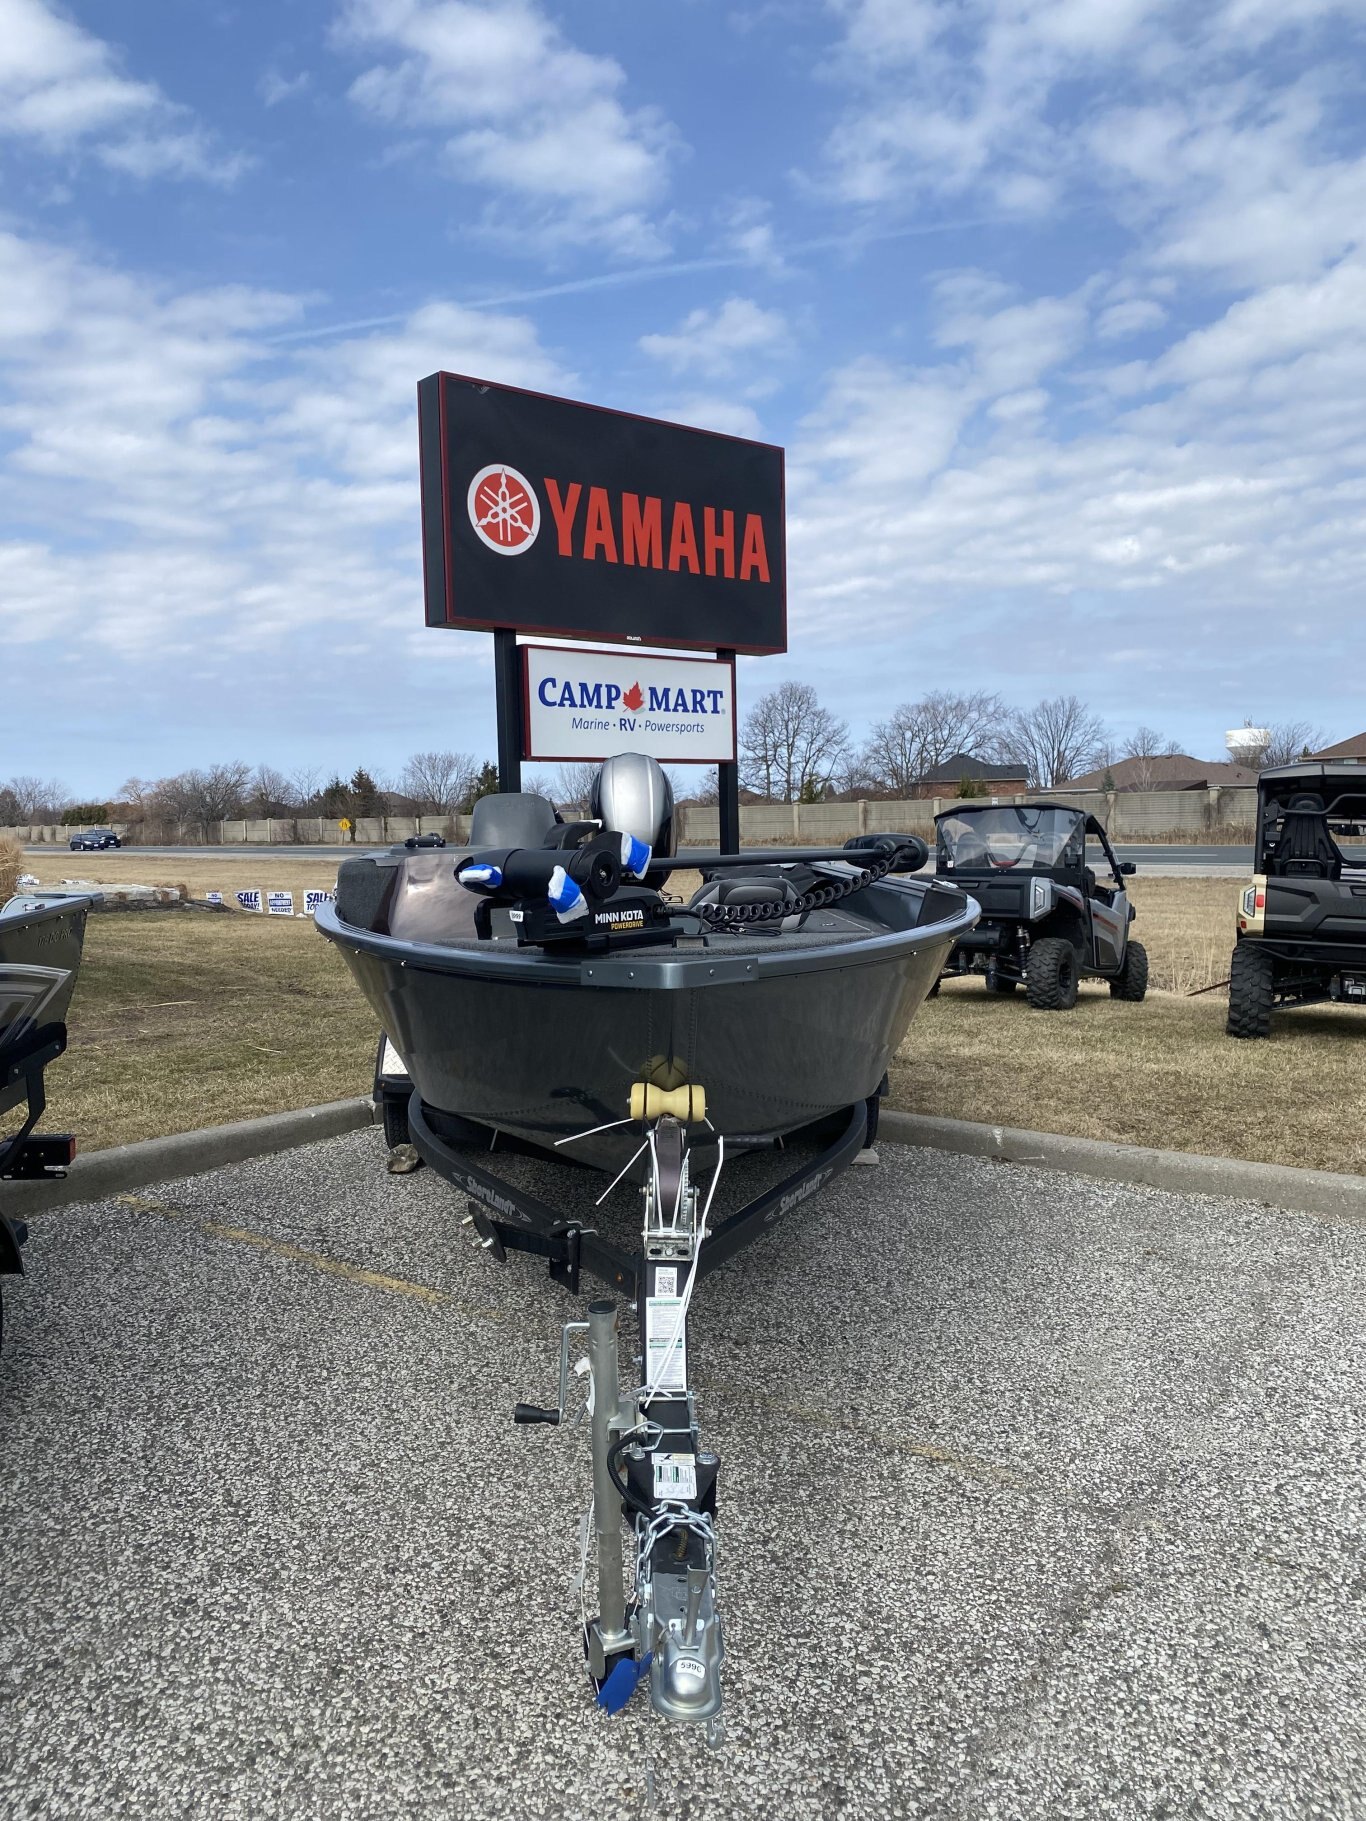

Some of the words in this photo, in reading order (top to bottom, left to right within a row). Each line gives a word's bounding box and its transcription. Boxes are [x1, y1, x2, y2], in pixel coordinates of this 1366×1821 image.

[543, 477, 771, 583] YAMAHA
[538, 677, 621, 710] CAMP
[648, 686, 724, 714] MART
[571, 717, 610, 731] Marine
[619, 718, 637, 732] RV
[644, 719, 705, 735] Powersports
[237, 892, 260, 903] SALE
[595, 911, 619, 925] MINN
[620, 909, 644, 921] KOTA
[610, 920, 644, 931] POWERDRIVE
